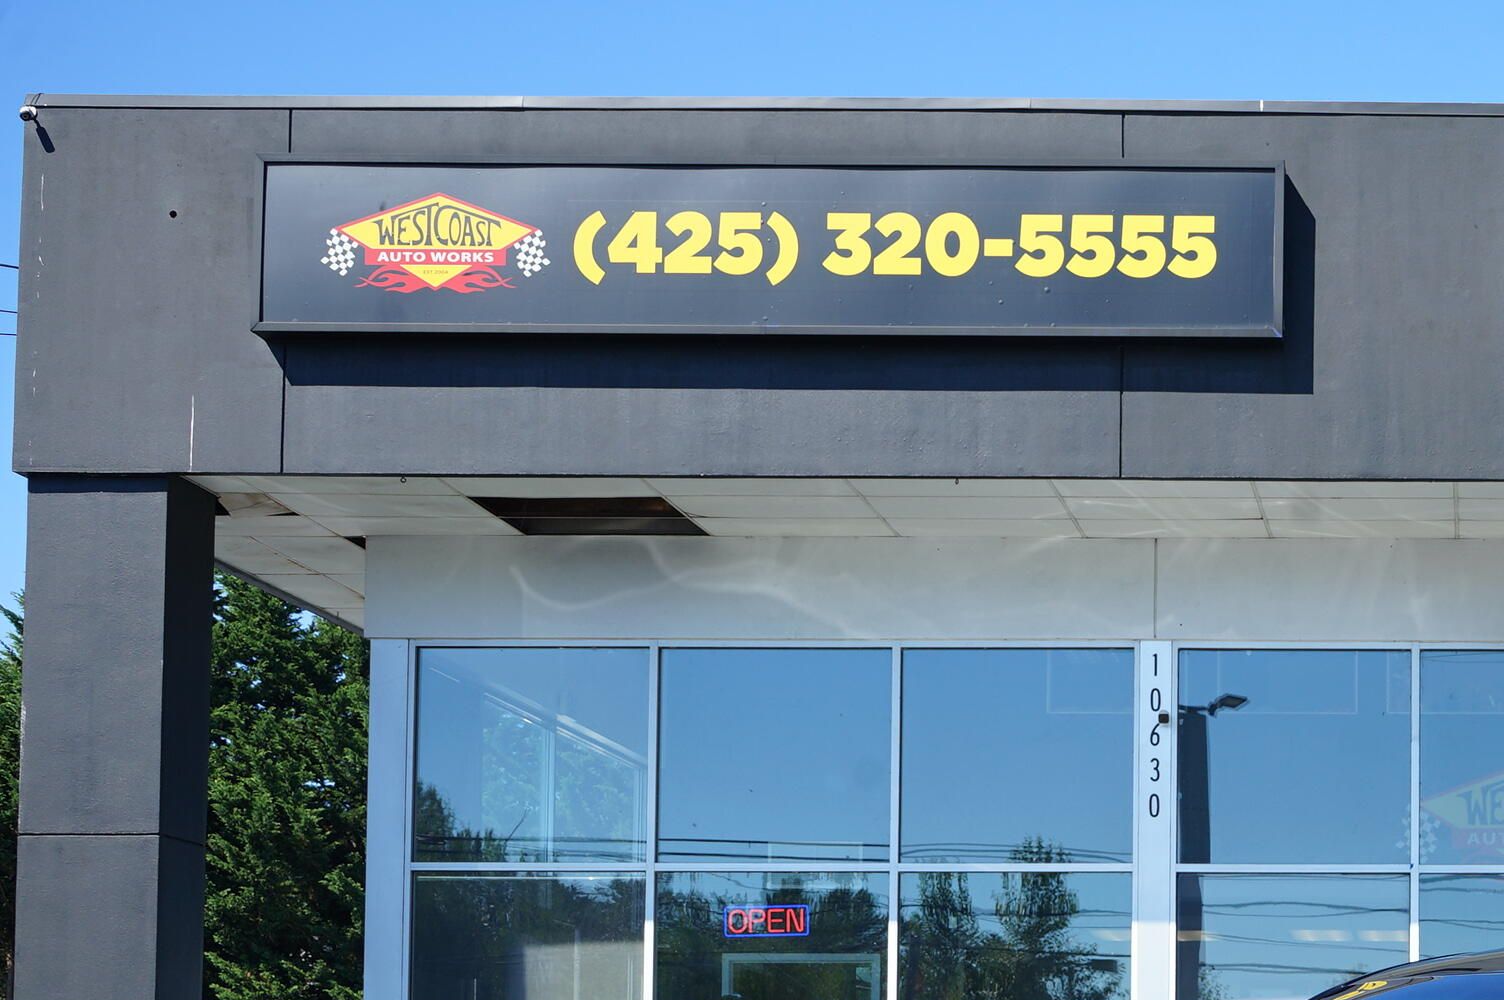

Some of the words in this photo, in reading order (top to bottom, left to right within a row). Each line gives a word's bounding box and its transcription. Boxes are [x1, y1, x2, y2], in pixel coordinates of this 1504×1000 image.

[377, 252, 427, 263] AUTO
[430, 252, 494, 263] WORKS
[574, 211, 798, 285] (425)
[822, 211, 1217, 279] 320-5555
[727, 908, 805, 934] OPEN
